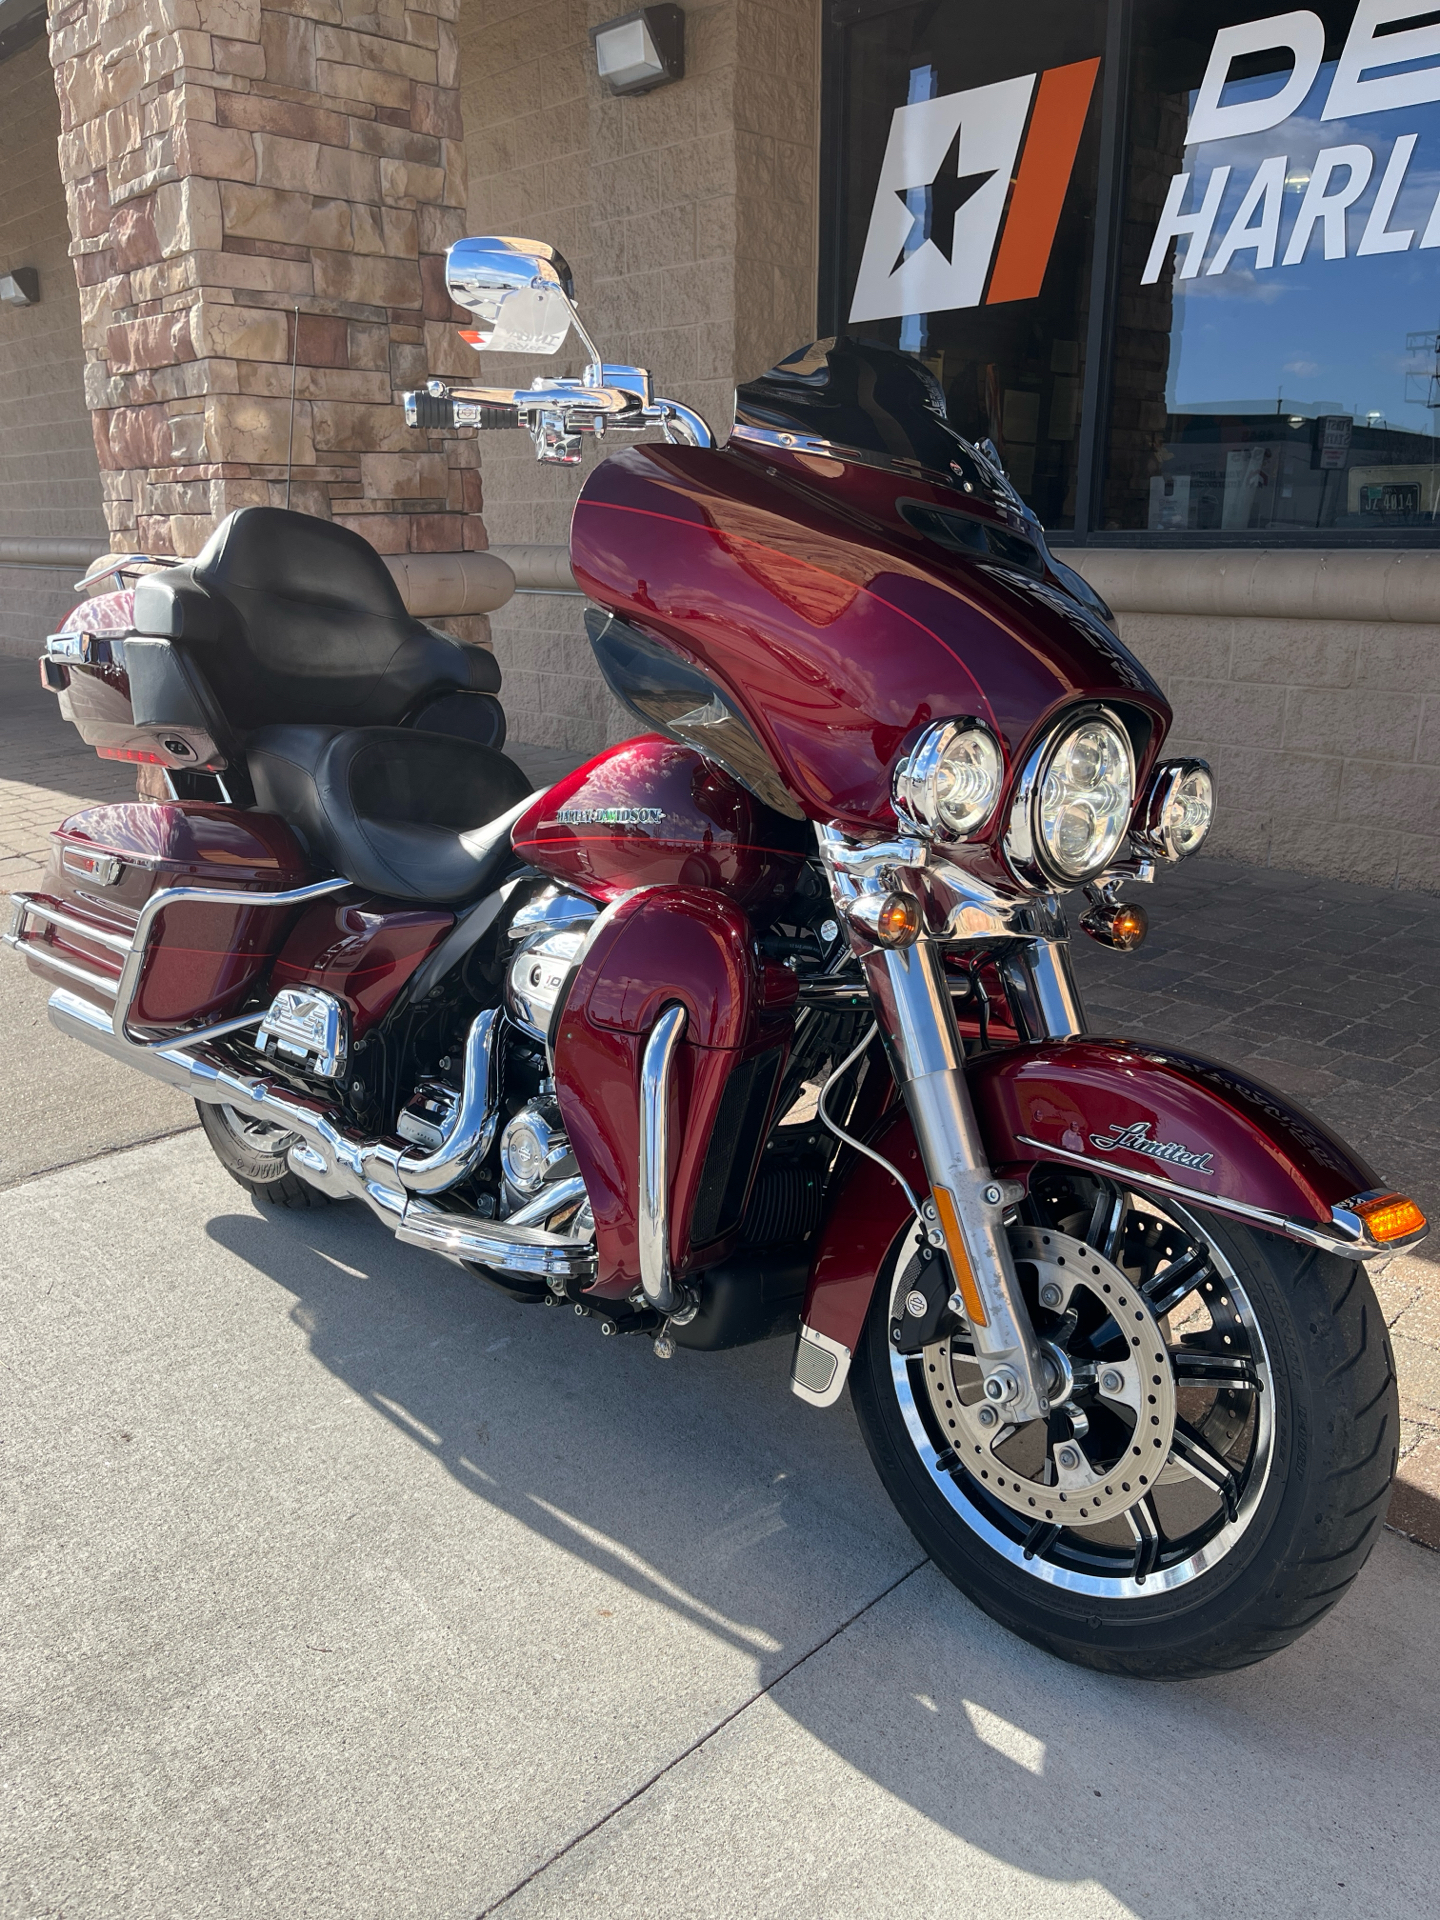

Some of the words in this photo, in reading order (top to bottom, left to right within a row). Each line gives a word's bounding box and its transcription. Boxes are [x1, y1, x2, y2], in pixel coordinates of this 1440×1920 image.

[1140, 134, 1440, 285] HARL
[557, 807, 667, 825] HARLEY-DAVIDSON
[1089, 1122, 1215, 1175] Limited
[1262, 1281, 1303, 1385] DUNLOP
